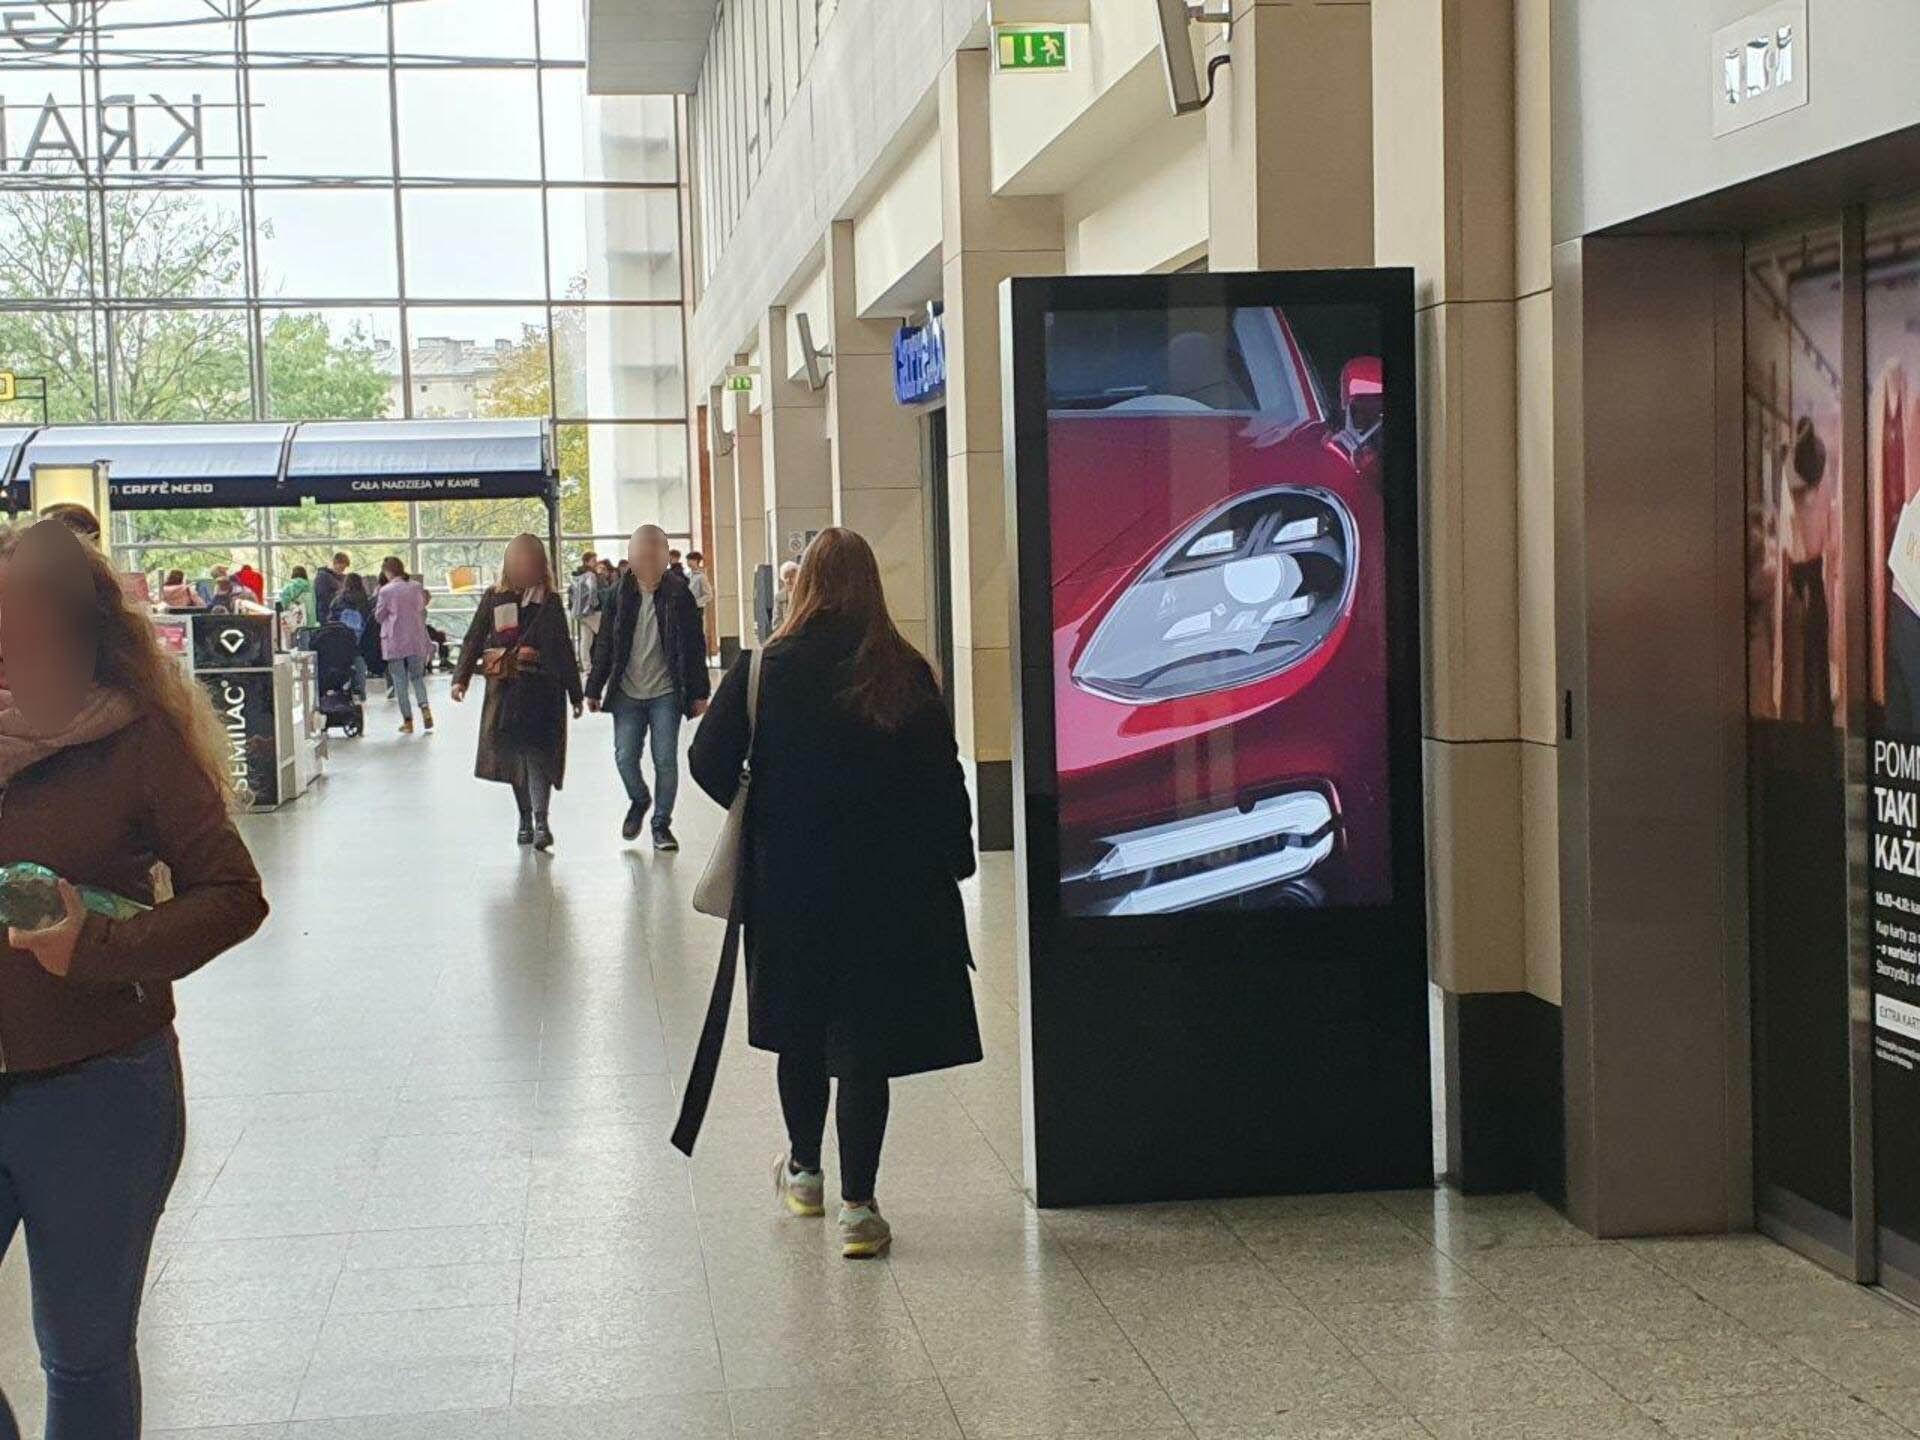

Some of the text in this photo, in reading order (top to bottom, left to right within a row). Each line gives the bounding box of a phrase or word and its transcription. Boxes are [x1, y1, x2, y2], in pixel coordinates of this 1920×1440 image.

[171, 483, 214, 494] NERO
[381, 480, 432, 490] NADZIEJA
[434, 479, 445, 488] W
[447, 478, 480, 488] KAWIE
[224, 686, 248, 791] SEMILAC
